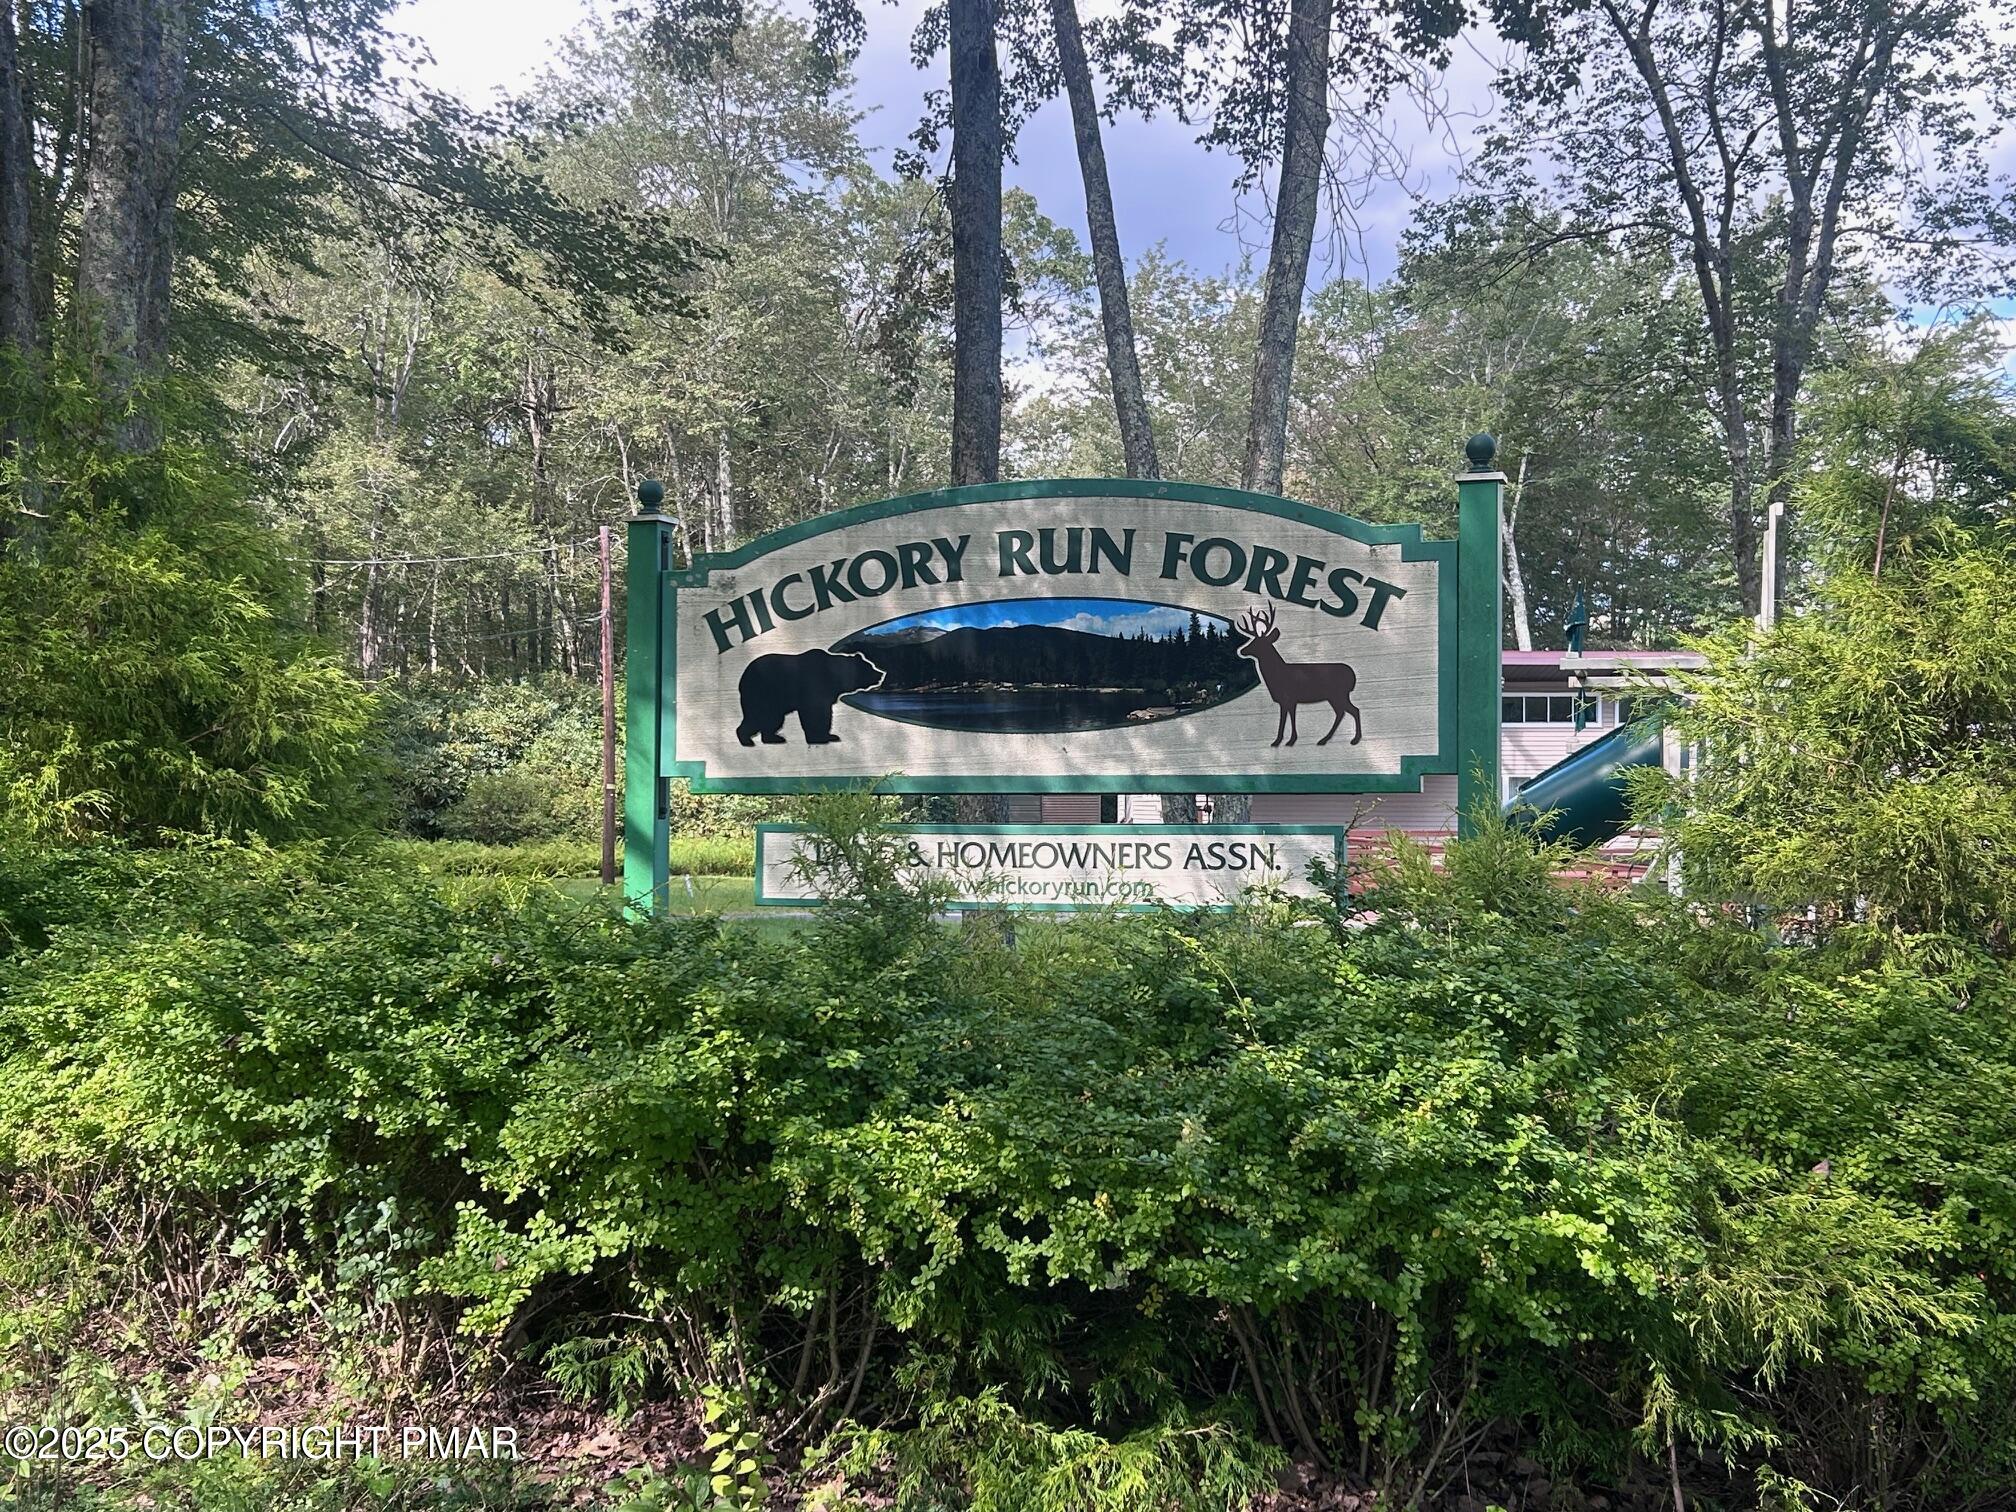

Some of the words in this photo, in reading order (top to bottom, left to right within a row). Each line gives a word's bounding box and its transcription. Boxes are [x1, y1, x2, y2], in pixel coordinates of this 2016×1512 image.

[702, 534, 970, 654] HICKORY
[998, 527, 1135, 577] RUN
[1160, 532, 1407, 630] FOREST
[907, 841, 931, 867] &
[937, 841, 1173, 870] HOMEOWNERS
[1183, 842, 1282, 871] ASSN.
